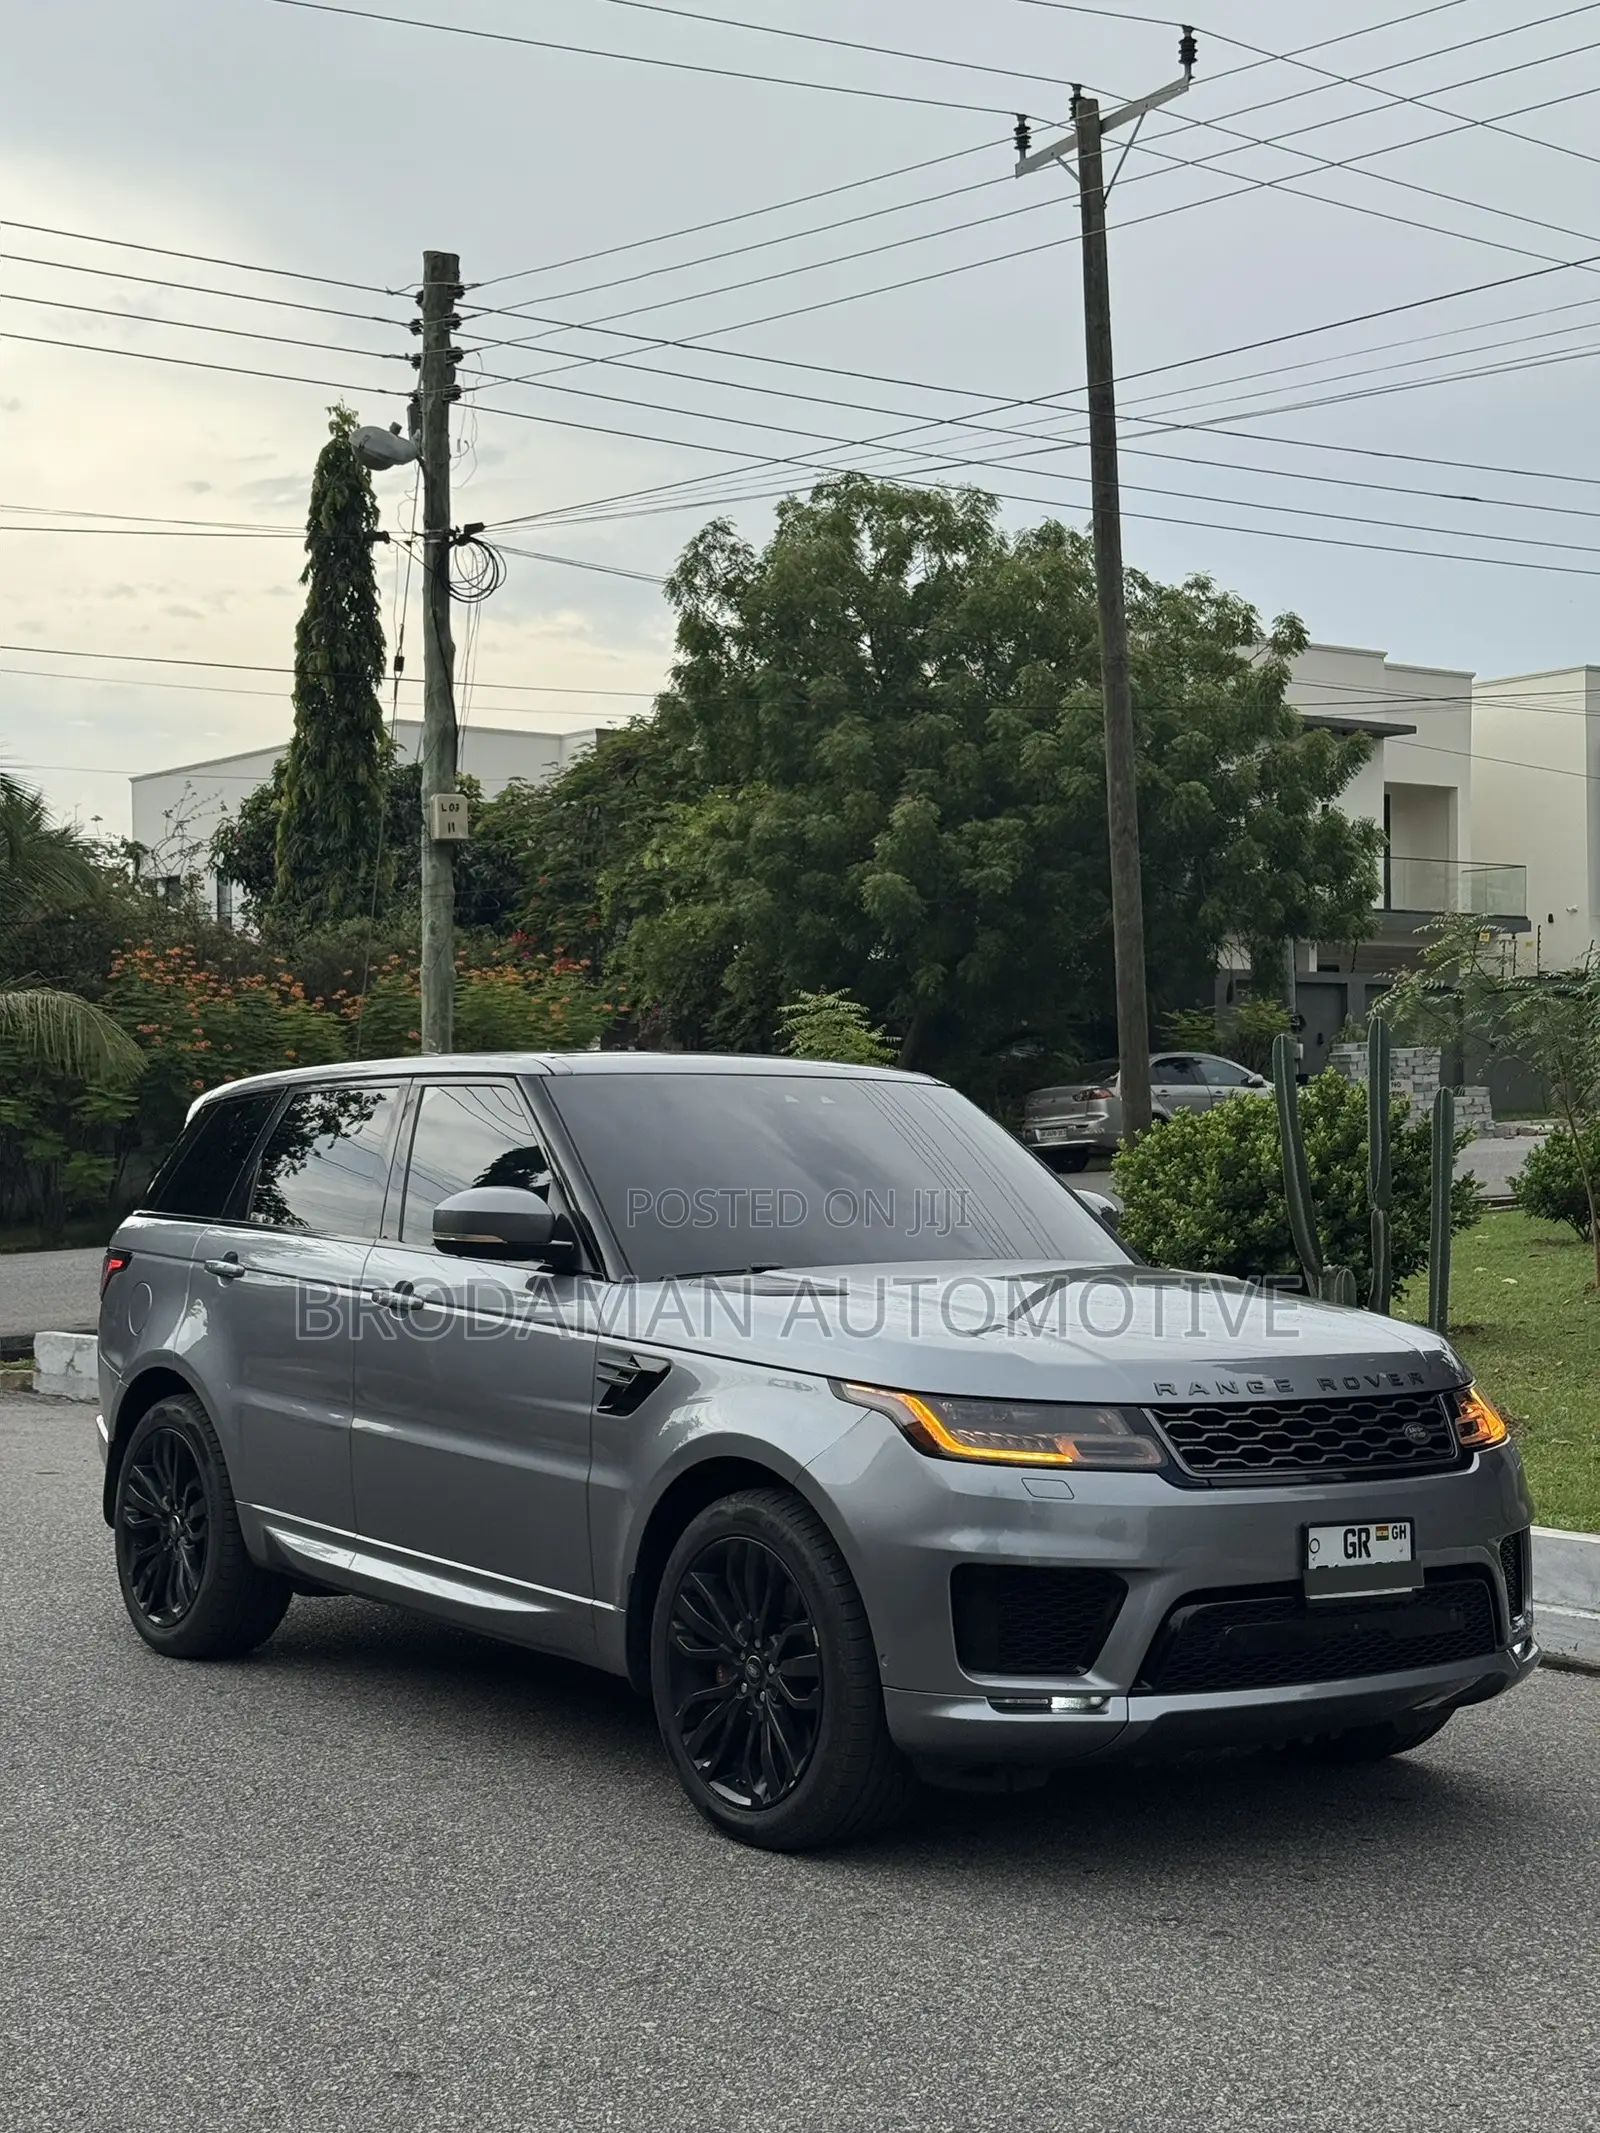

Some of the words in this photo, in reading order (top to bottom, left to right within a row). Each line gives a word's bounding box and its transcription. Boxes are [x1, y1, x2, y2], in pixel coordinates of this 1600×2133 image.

[1154, 1378, 1295, 1397] RANGE
[1316, 1371, 1425, 1392] ROVER
[1343, 1527, 1371, 1559] GR
[1391, 1525, 1407, 1540] GH
